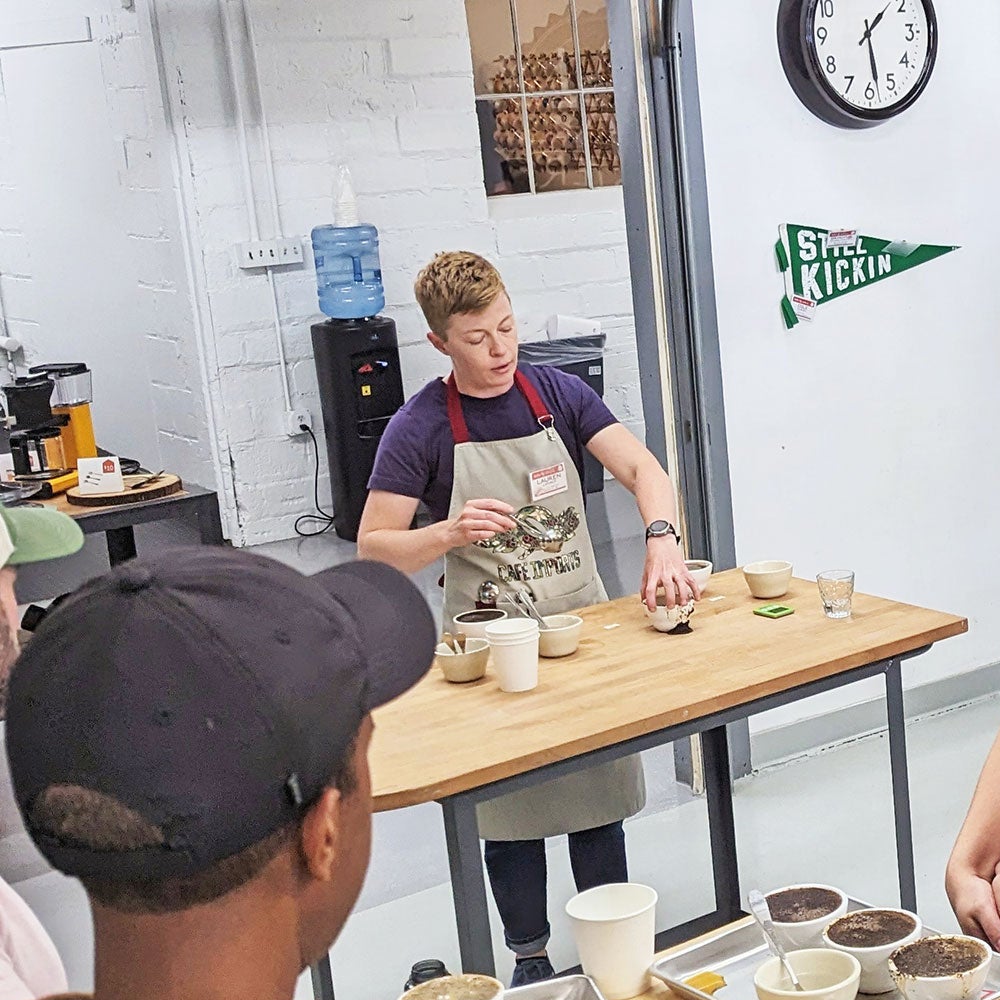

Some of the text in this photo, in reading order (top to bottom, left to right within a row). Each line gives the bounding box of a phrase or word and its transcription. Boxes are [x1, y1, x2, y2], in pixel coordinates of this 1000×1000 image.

[819, 0, 834, 18] 10
[897, 0, 906, 13] 2
[816, 26, 828, 46] 9
[904, 23, 915, 42] 3
[826, 55, 837, 74] 8
[899, 51, 909, 69] 4
[844, 75, 855, 95] 7
[864, 81, 875, 100] 6
[886, 73, 896, 91] 5
[800, 253, 892, 301] KICKIN
[497, 549, 581, 583] CAFE IMPORTS
